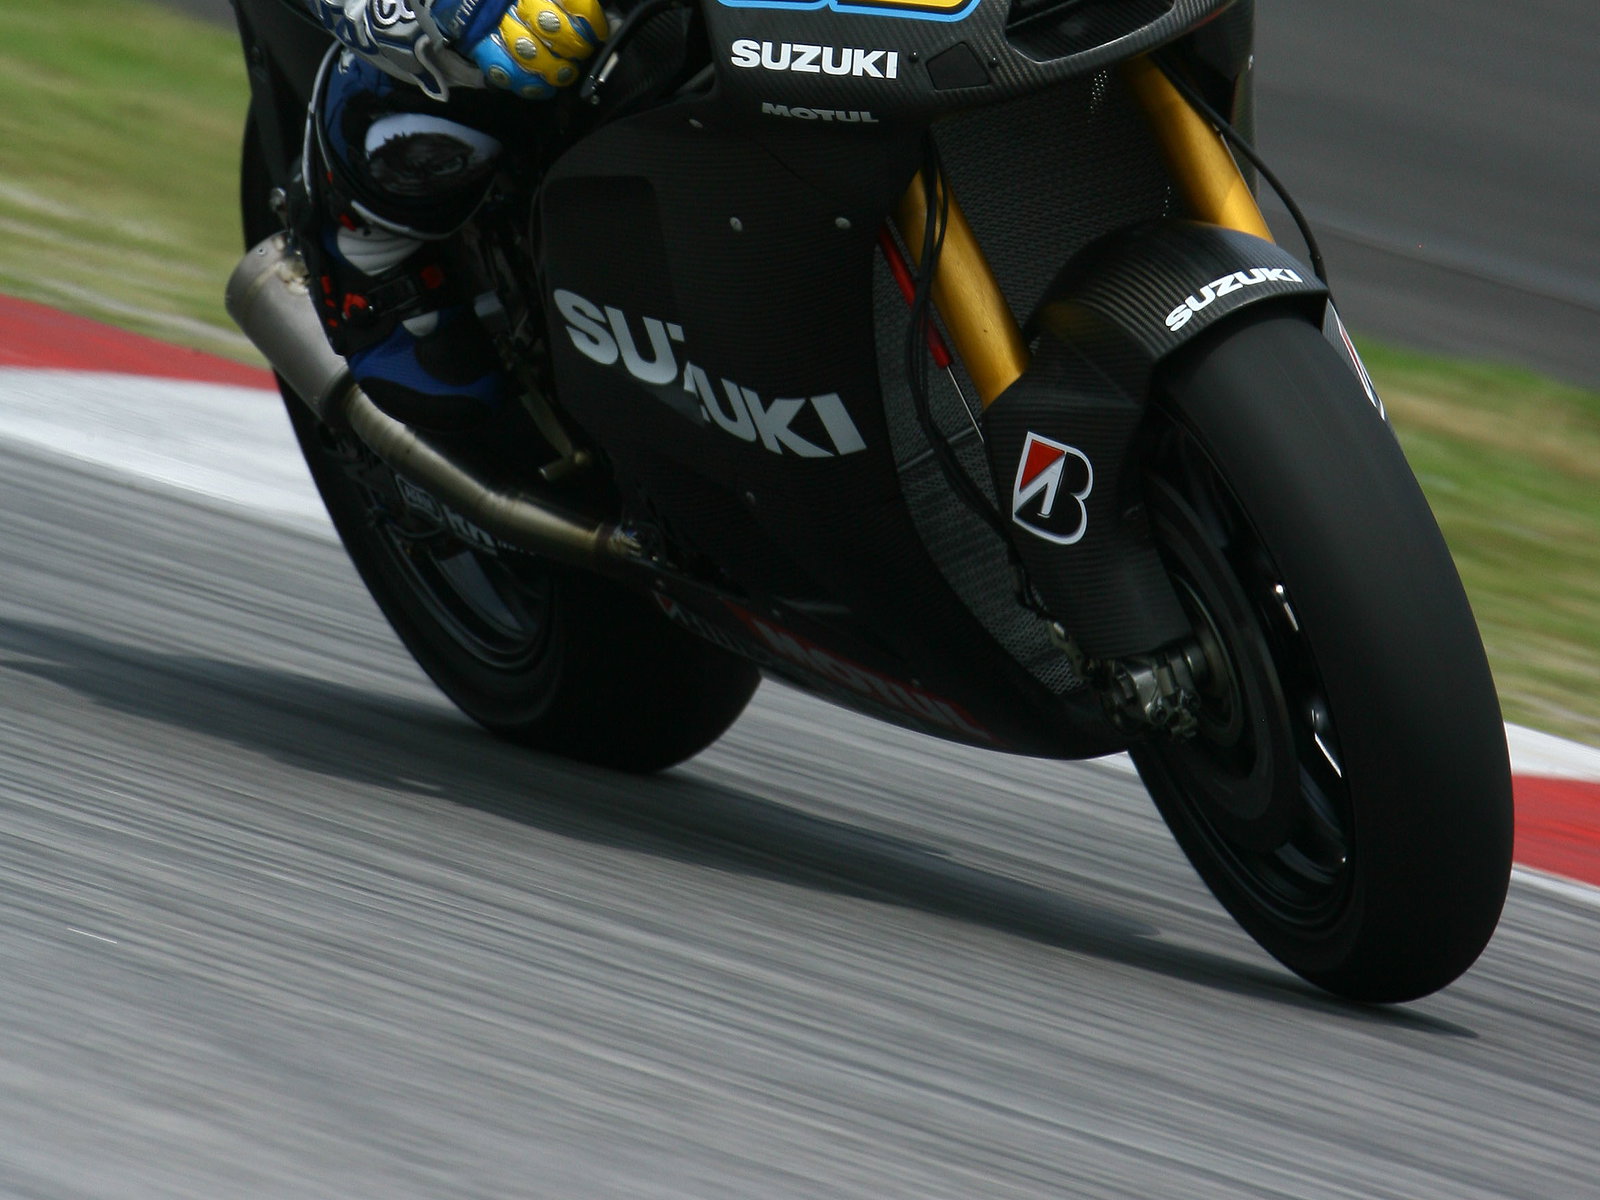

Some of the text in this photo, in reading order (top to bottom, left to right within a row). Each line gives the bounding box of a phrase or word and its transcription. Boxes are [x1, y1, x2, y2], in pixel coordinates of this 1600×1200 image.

[731, 39, 899, 80] SUZUKI
[761, 102, 880, 124] MOTUL
[1165, 266, 1304, 332] SUZUKI
